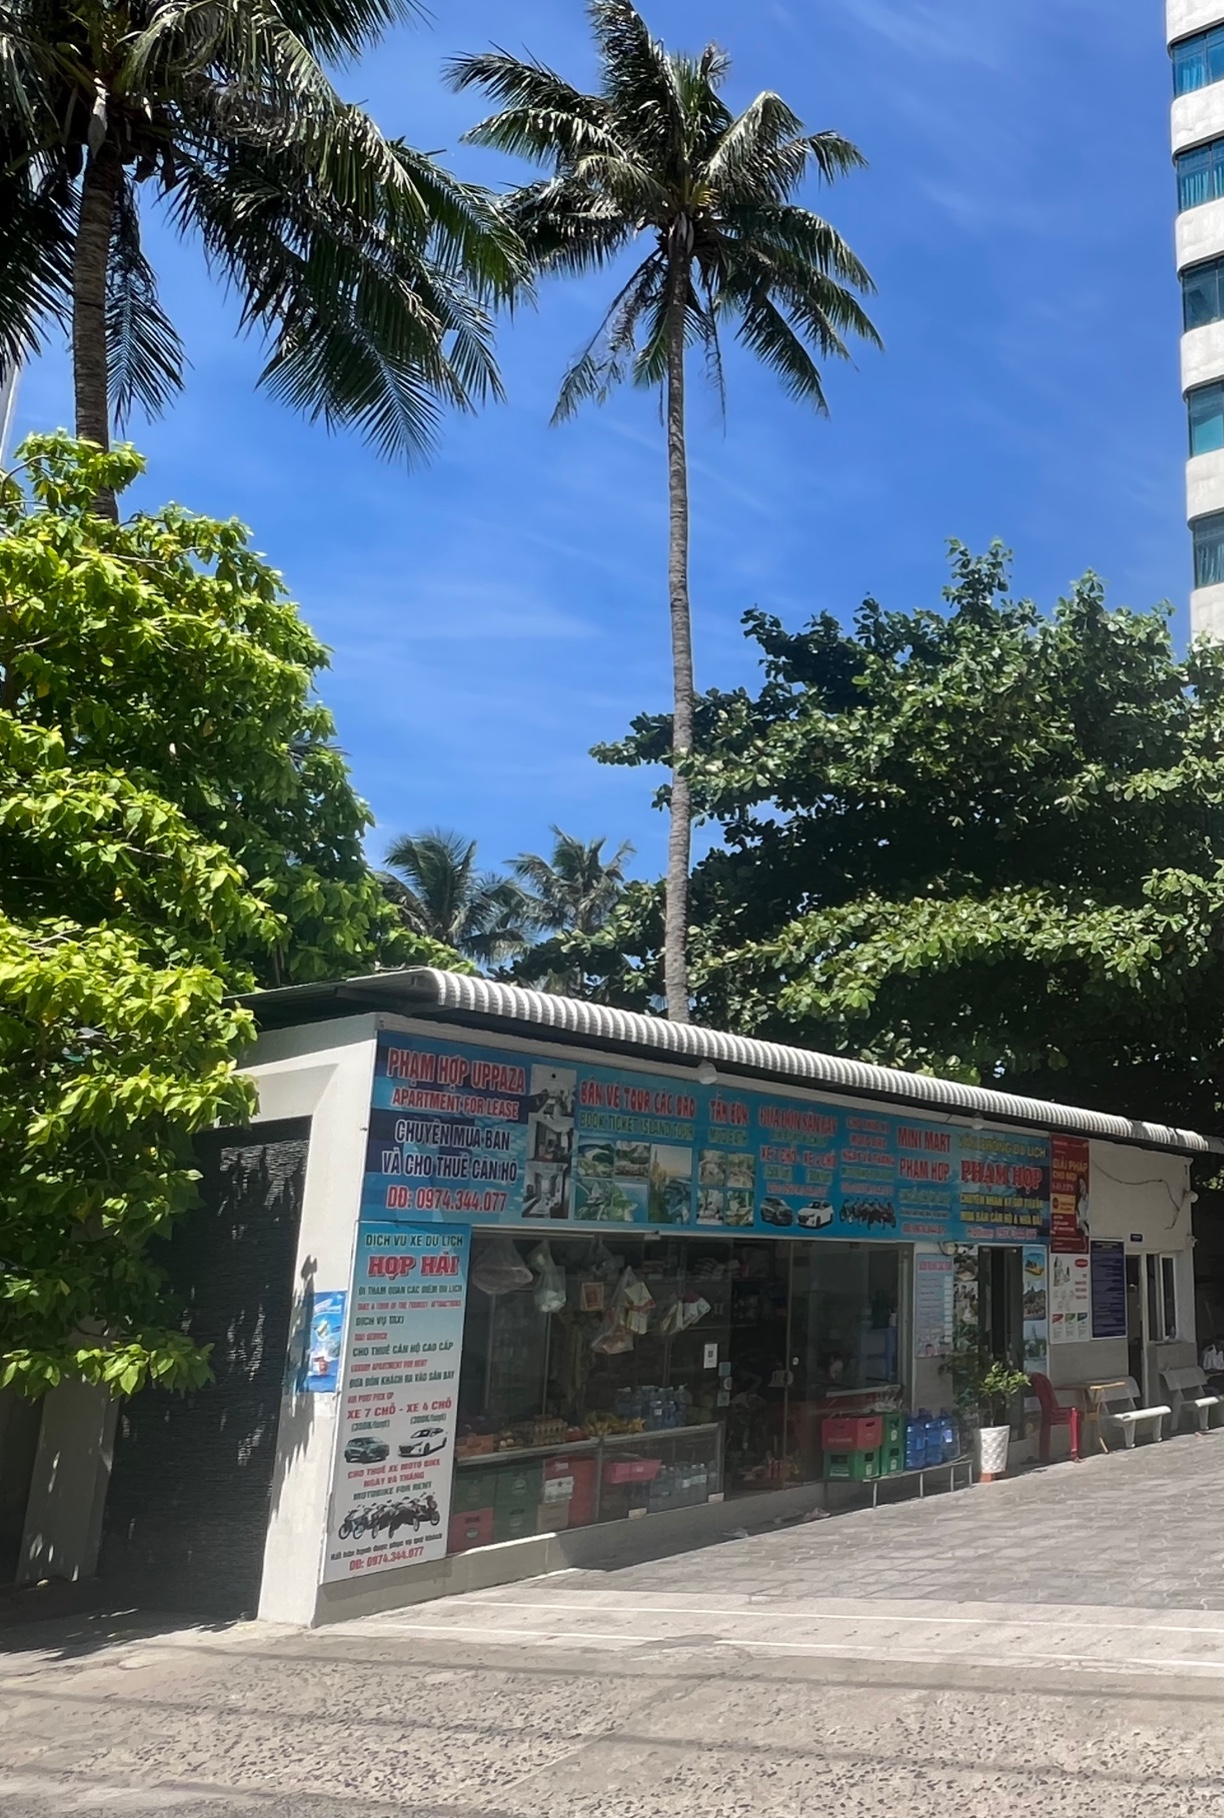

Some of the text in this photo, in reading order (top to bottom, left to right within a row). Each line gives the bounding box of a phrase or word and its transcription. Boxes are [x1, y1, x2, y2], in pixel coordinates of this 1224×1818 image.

[388, 1048, 525, 1095] PHẠM HỢP UPPAZA
[393, 1088, 519, 1120] APARTMENT FOR LEASE
[624, 1087, 651, 1113] TOUR
[395, 1119, 451, 1145] CHUYÊN
[452, 1126, 482, 1148] MUA
[580, 1111, 604, 1130] BOOK
[608, 1114, 636, 1133] TICKET
[640, 1119, 670, 1138] ISLAND
[898, 1127, 951, 1153] MINI MART
[404, 1154, 433, 1177] CHO
[436, 1153, 470, 1179] THUÊ
[416, 1187, 507, 1211] 0974.344.077
[410, 1235, 423, 1246] XE
[426, 1235, 439, 1246] DU
[353, 1347, 369, 1357] CHO
[422, 1342, 437, 1352] CAO
[347, 1408, 361, 1420] XE
[364, 1407, 371, 1418] 7
[406, 1402, 419, 1413] XE
[422, 1402, 428, 1411] 4
[388, 1464, 398, 1473] XE
[396, 1484, 410, 1494] FOR
[366, 1546, 424, 1567] 0974.344.077
